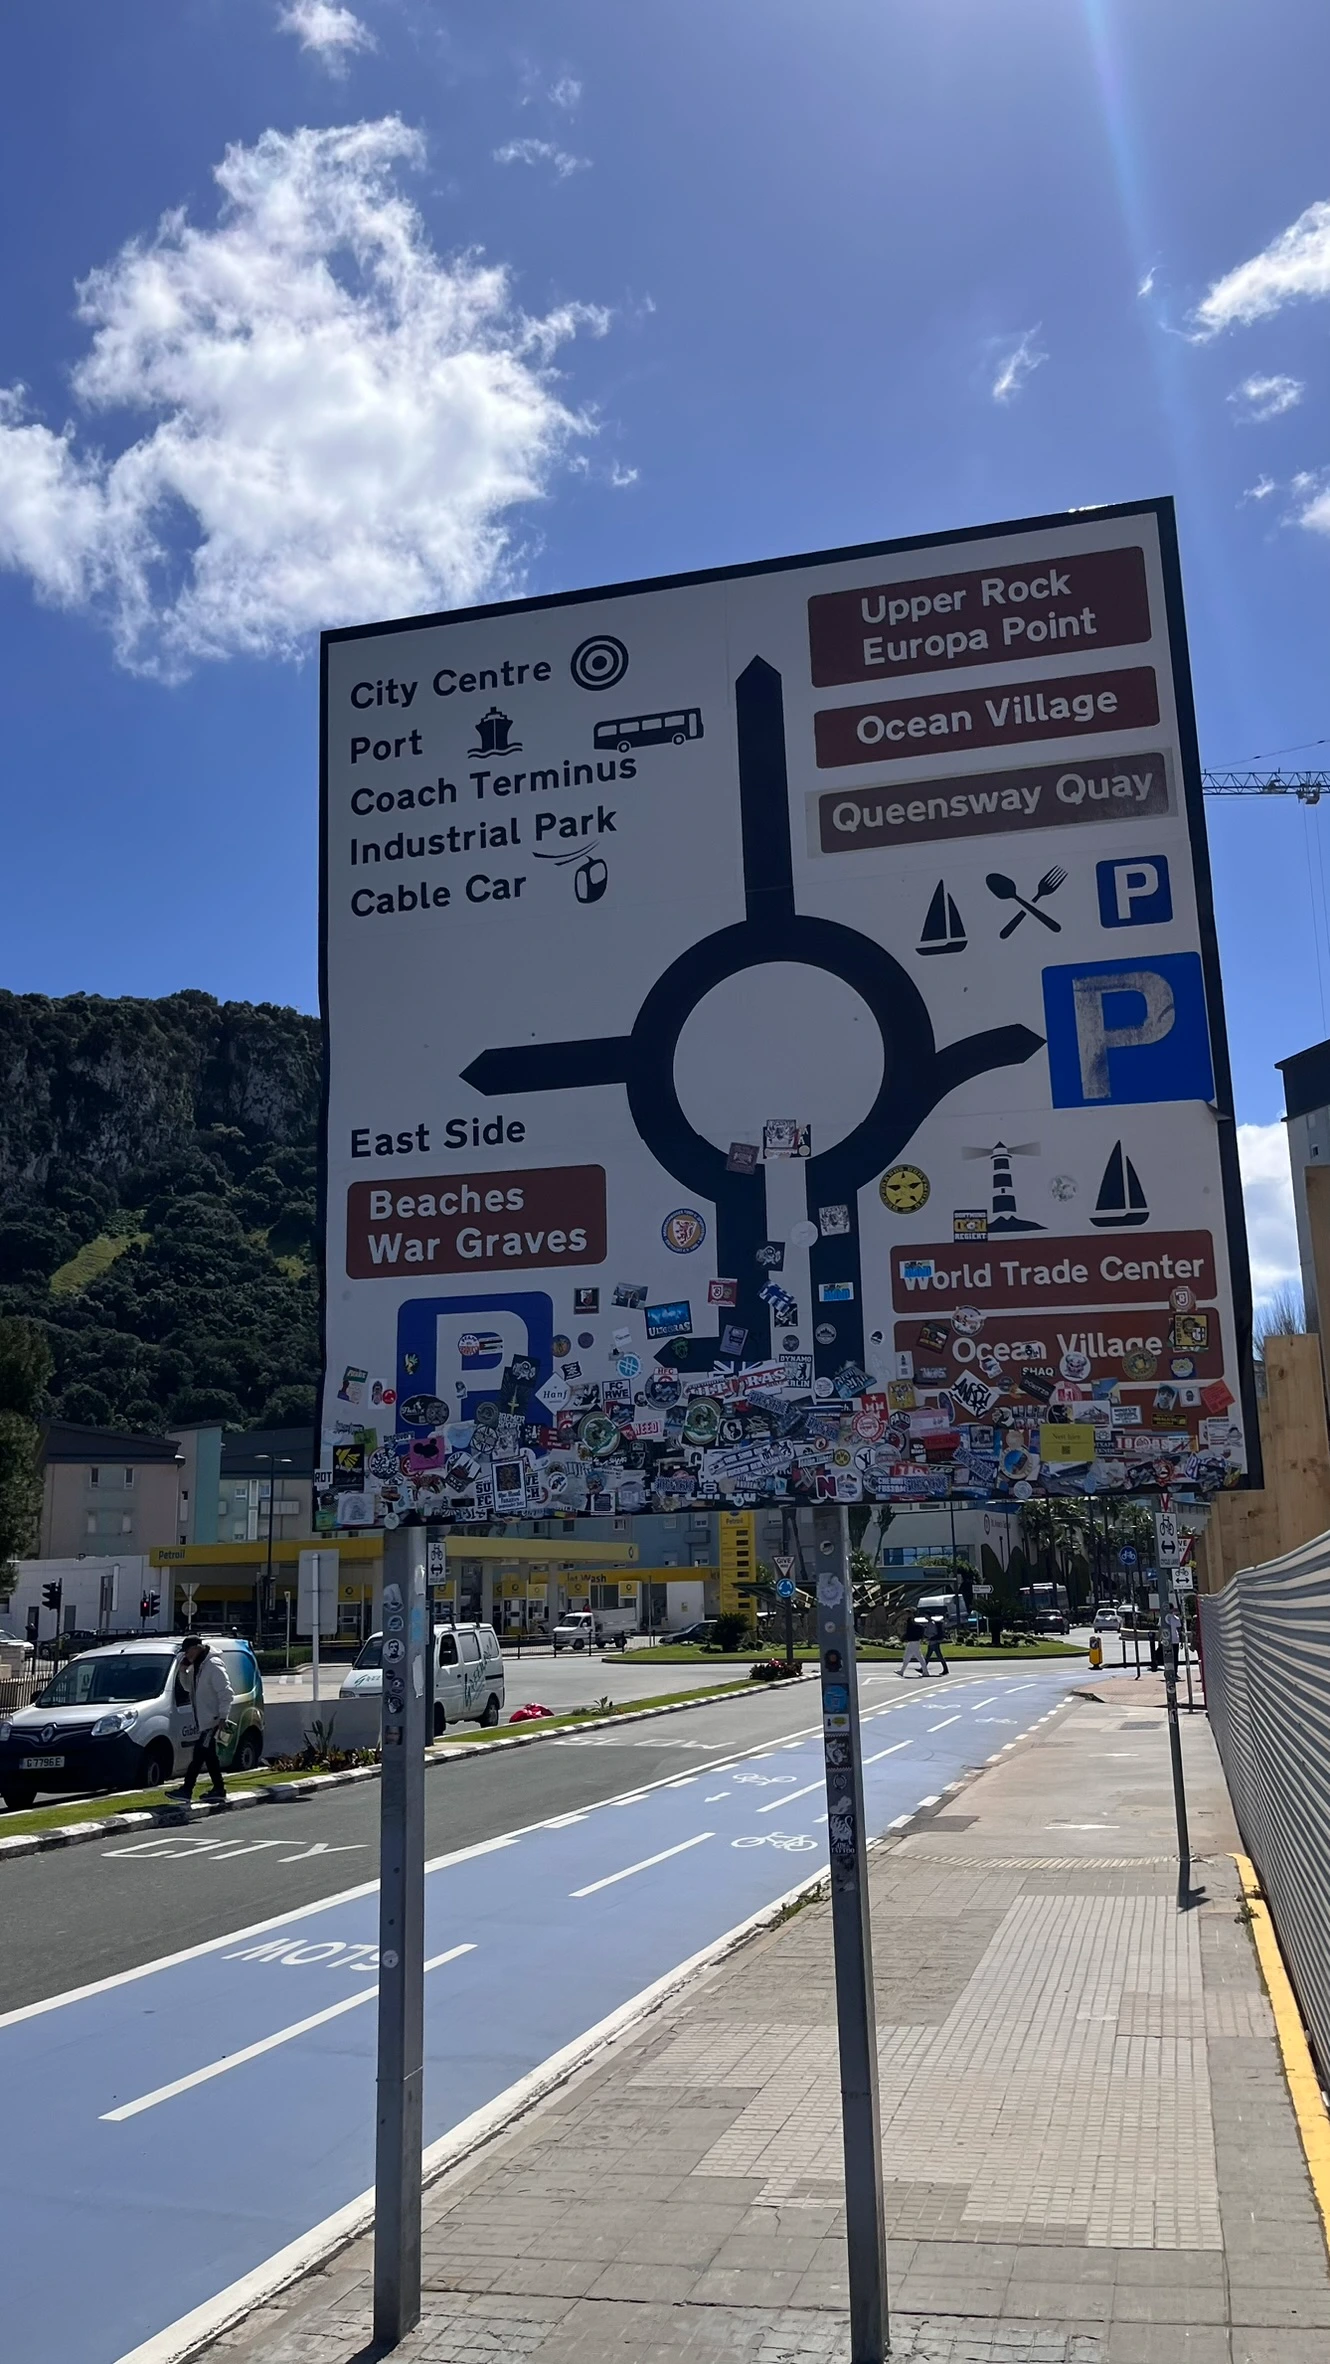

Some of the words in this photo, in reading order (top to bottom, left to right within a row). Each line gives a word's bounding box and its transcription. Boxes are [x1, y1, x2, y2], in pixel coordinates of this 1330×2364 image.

[861, 585, 967, 625] Upper
[981, 569, 1072, 607] Rock
[863, 627, 988, 666] Europa
[1002, 607, 1098, 646] Point
[350, 679, 418, 708] City
[432, 661, 552, 697] Centre
[856, 707, 973, 745] Ocean
[985, 690, 1118, 727] Village
[350, 729, 423, 764] Port
[351, 778, 457, 816] Coach
[470, 757, 637, 800] Terminus
[832, 785, 1042, 832] Queensway
[1055, 770, 1153, 804] Quay
[350, 818, 521, 865] Industrial
[536, 806, 617, 841] Park
[351, 882, 451, 917] Cable
[466, 874, 526, 903] Car
[1114, 863, 1159, 920] P
[1072, 971, 1175, 1100] P
[351, 1123, 430, 1158] East
[443, 1115, 525, 1149] Side
[369, 1184, 525, 1221] Beaches
[367, 1233, 440, 1264] War
[455, 1226, 588, 1259] Graves
[1001, 1259, 1088, 1286] Trade
[1100, 1254, 1205, 1282] Center
[436, 1310, 529, 1420] P
[1023, 1367, 1054, 1377] SHAQ
[543, 1390, 567, 1399] Hanf
[605, 1389, 628, 1400] RWE
[609, 1381, 623, 1390] FC
[159, 1550, 185, 1560] Petroil
[582, 1572, 607, 1584] Wash
[553, 1738, 736, 1749] SLOW
[100, 1837, 371, 1863] CITY
